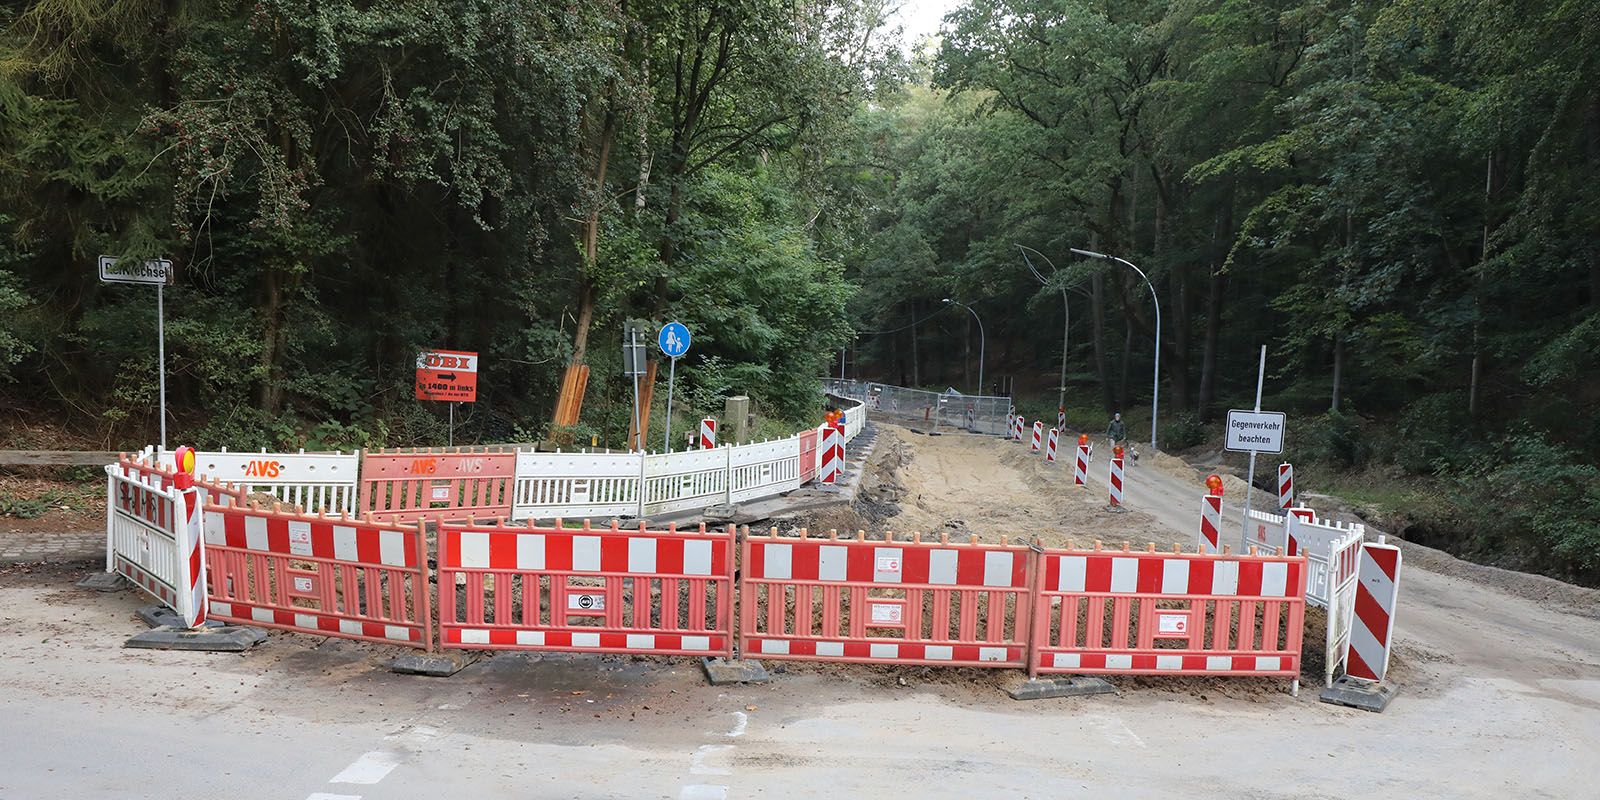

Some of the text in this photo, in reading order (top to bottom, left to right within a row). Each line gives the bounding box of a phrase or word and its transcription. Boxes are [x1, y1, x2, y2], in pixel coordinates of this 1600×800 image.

[426, 355, 471, 369] OBI
[1231, 419, 1281, 430] Gegenverkehr
[1238, 434, 1271, 444] beachten
[245, 460, 280, 478] AVS
[411, 458, 437, 475] AVS
[460, 458, 483, 473] AVS
